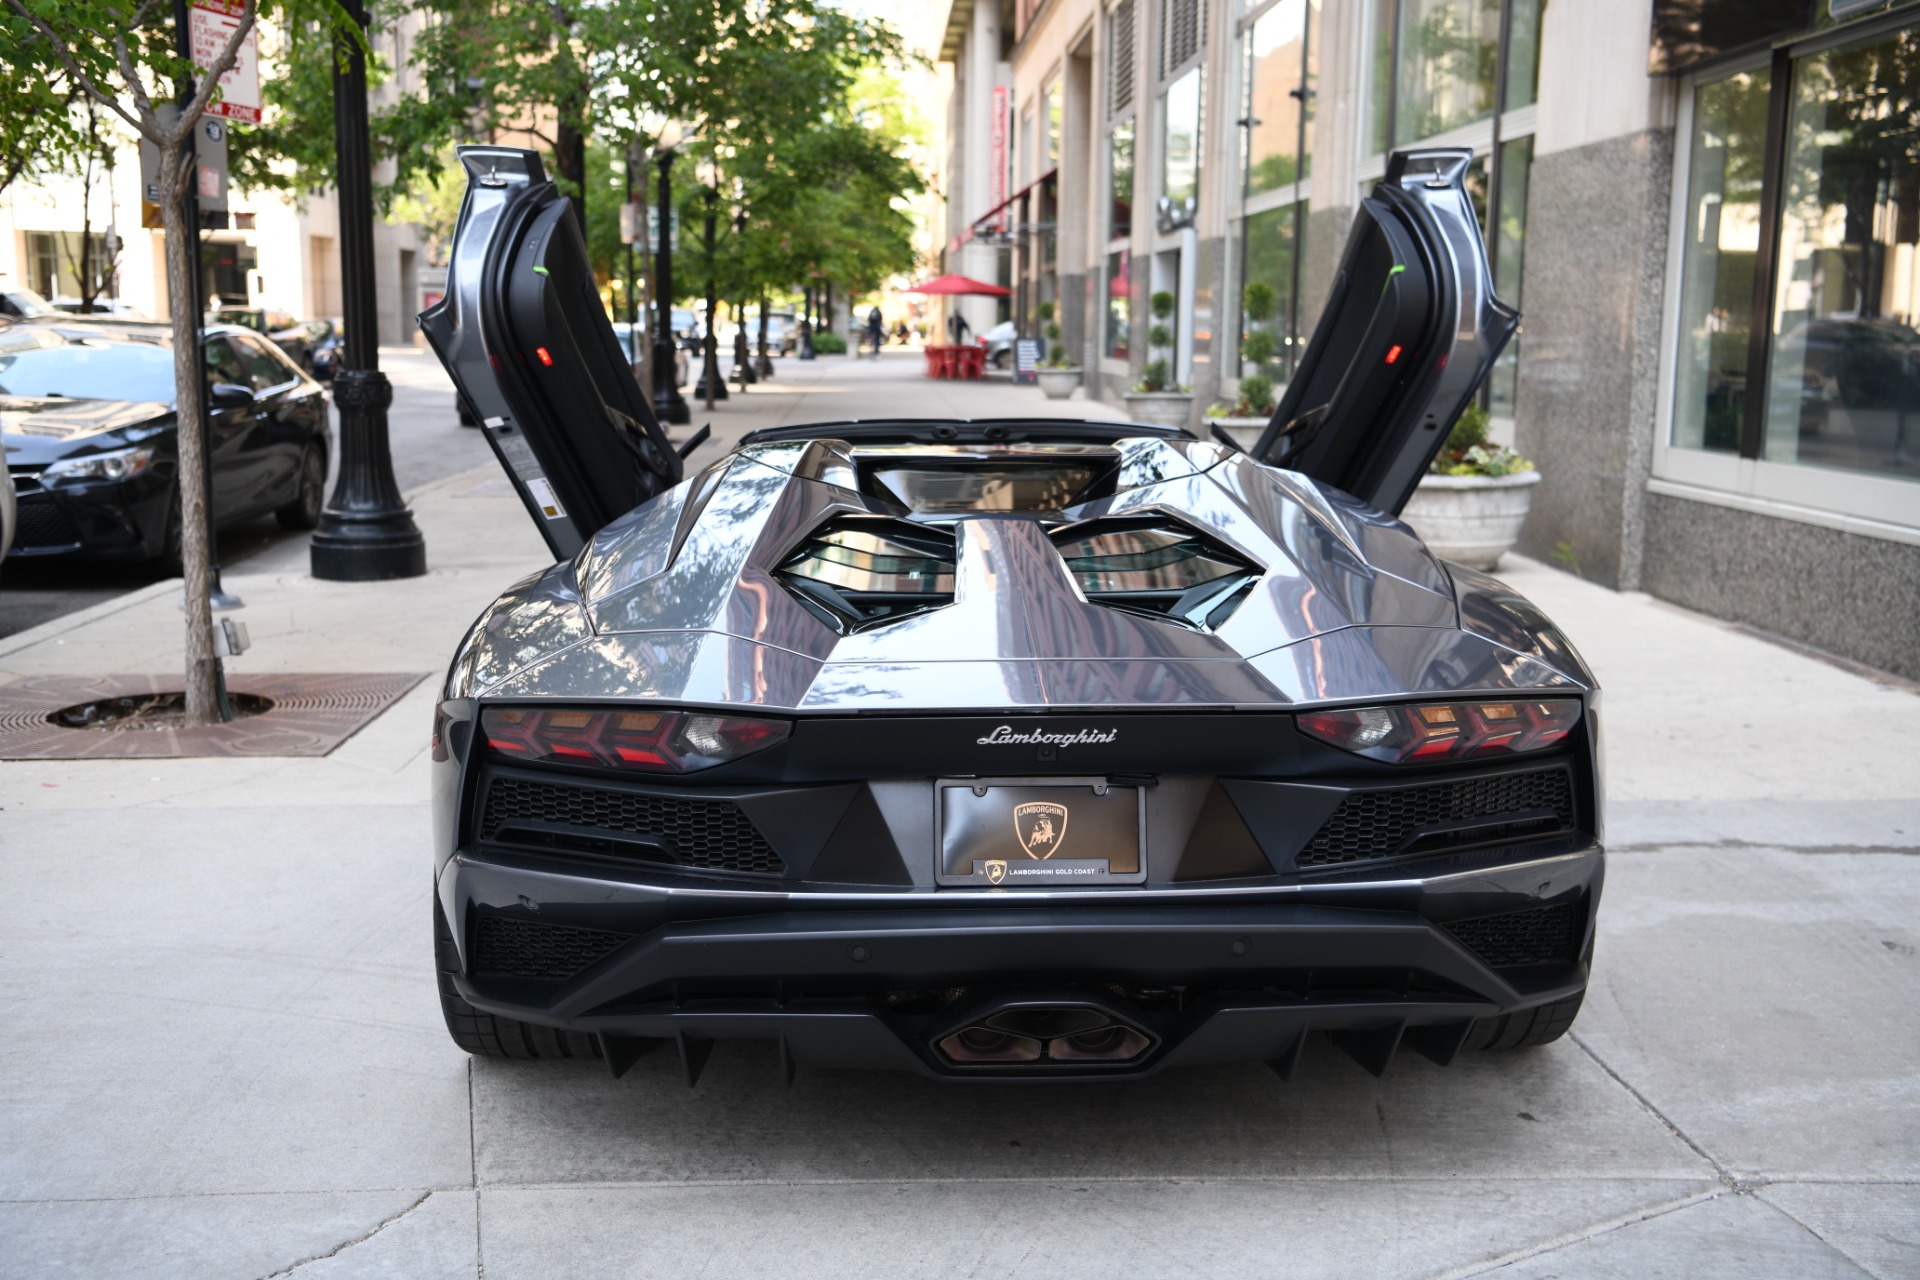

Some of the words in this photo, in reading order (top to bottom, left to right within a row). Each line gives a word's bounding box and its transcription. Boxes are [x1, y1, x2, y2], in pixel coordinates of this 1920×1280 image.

[228, 104, 255, 120] ZONE
[977, 725, 1117, 747] Lamborghini
[1018, 805, 1063, 817] LAMBORGHINI
